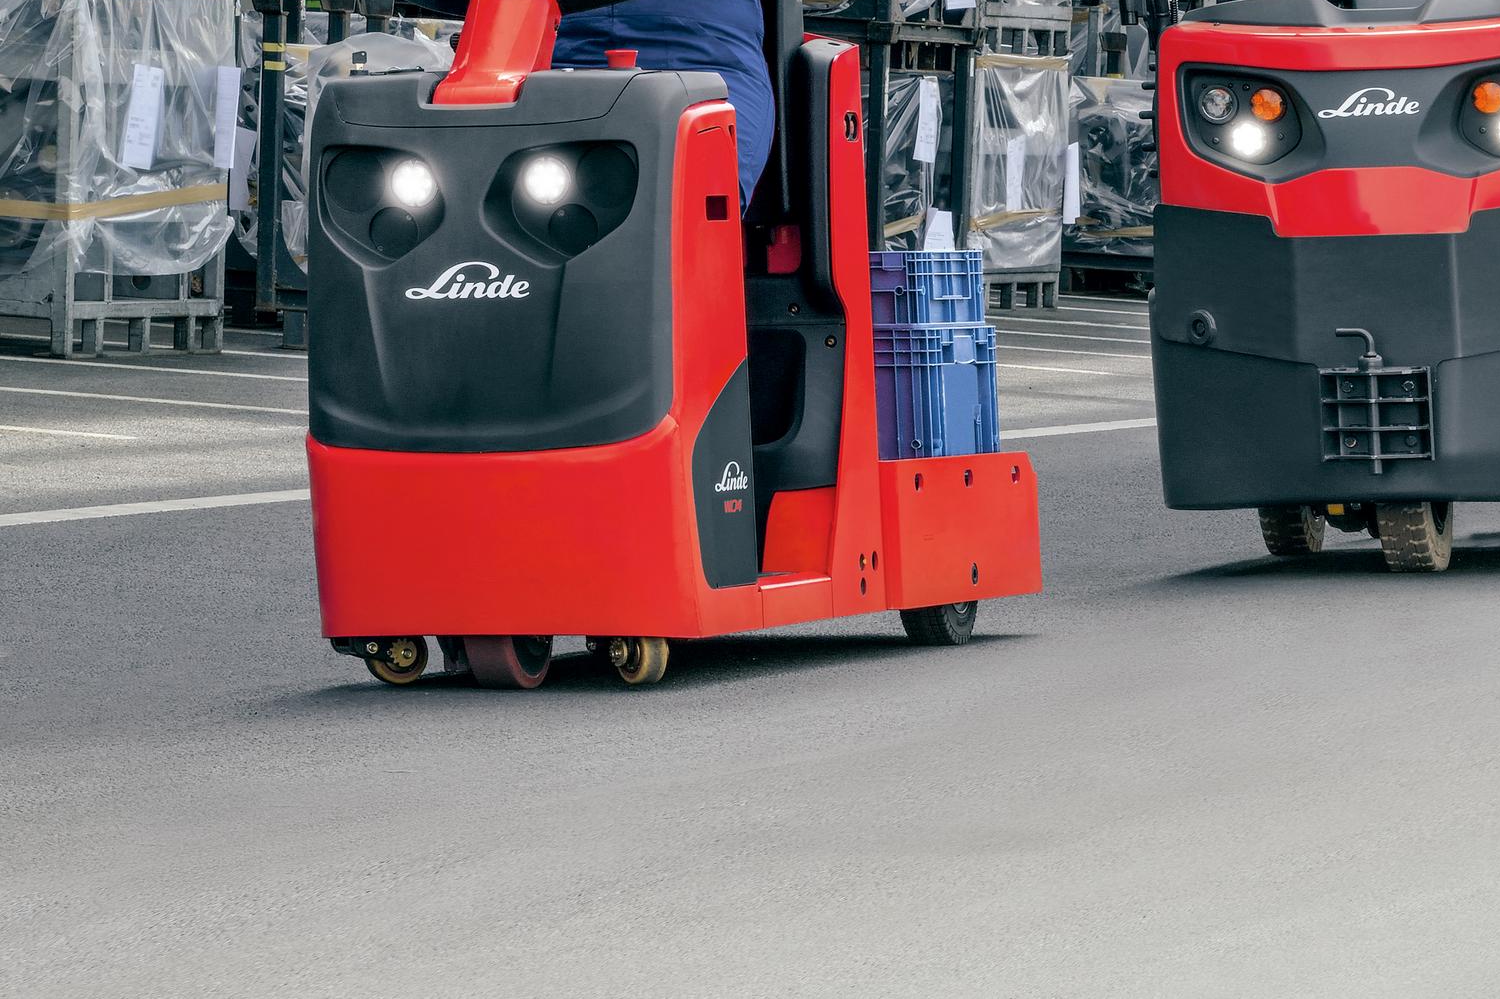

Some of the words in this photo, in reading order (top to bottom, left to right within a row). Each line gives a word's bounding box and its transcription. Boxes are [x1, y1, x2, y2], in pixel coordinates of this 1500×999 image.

[1317, 87, 1420, 119] Linde
[405, 261, 530, 300] Linde
[714, 460, 749, 493] Linde
